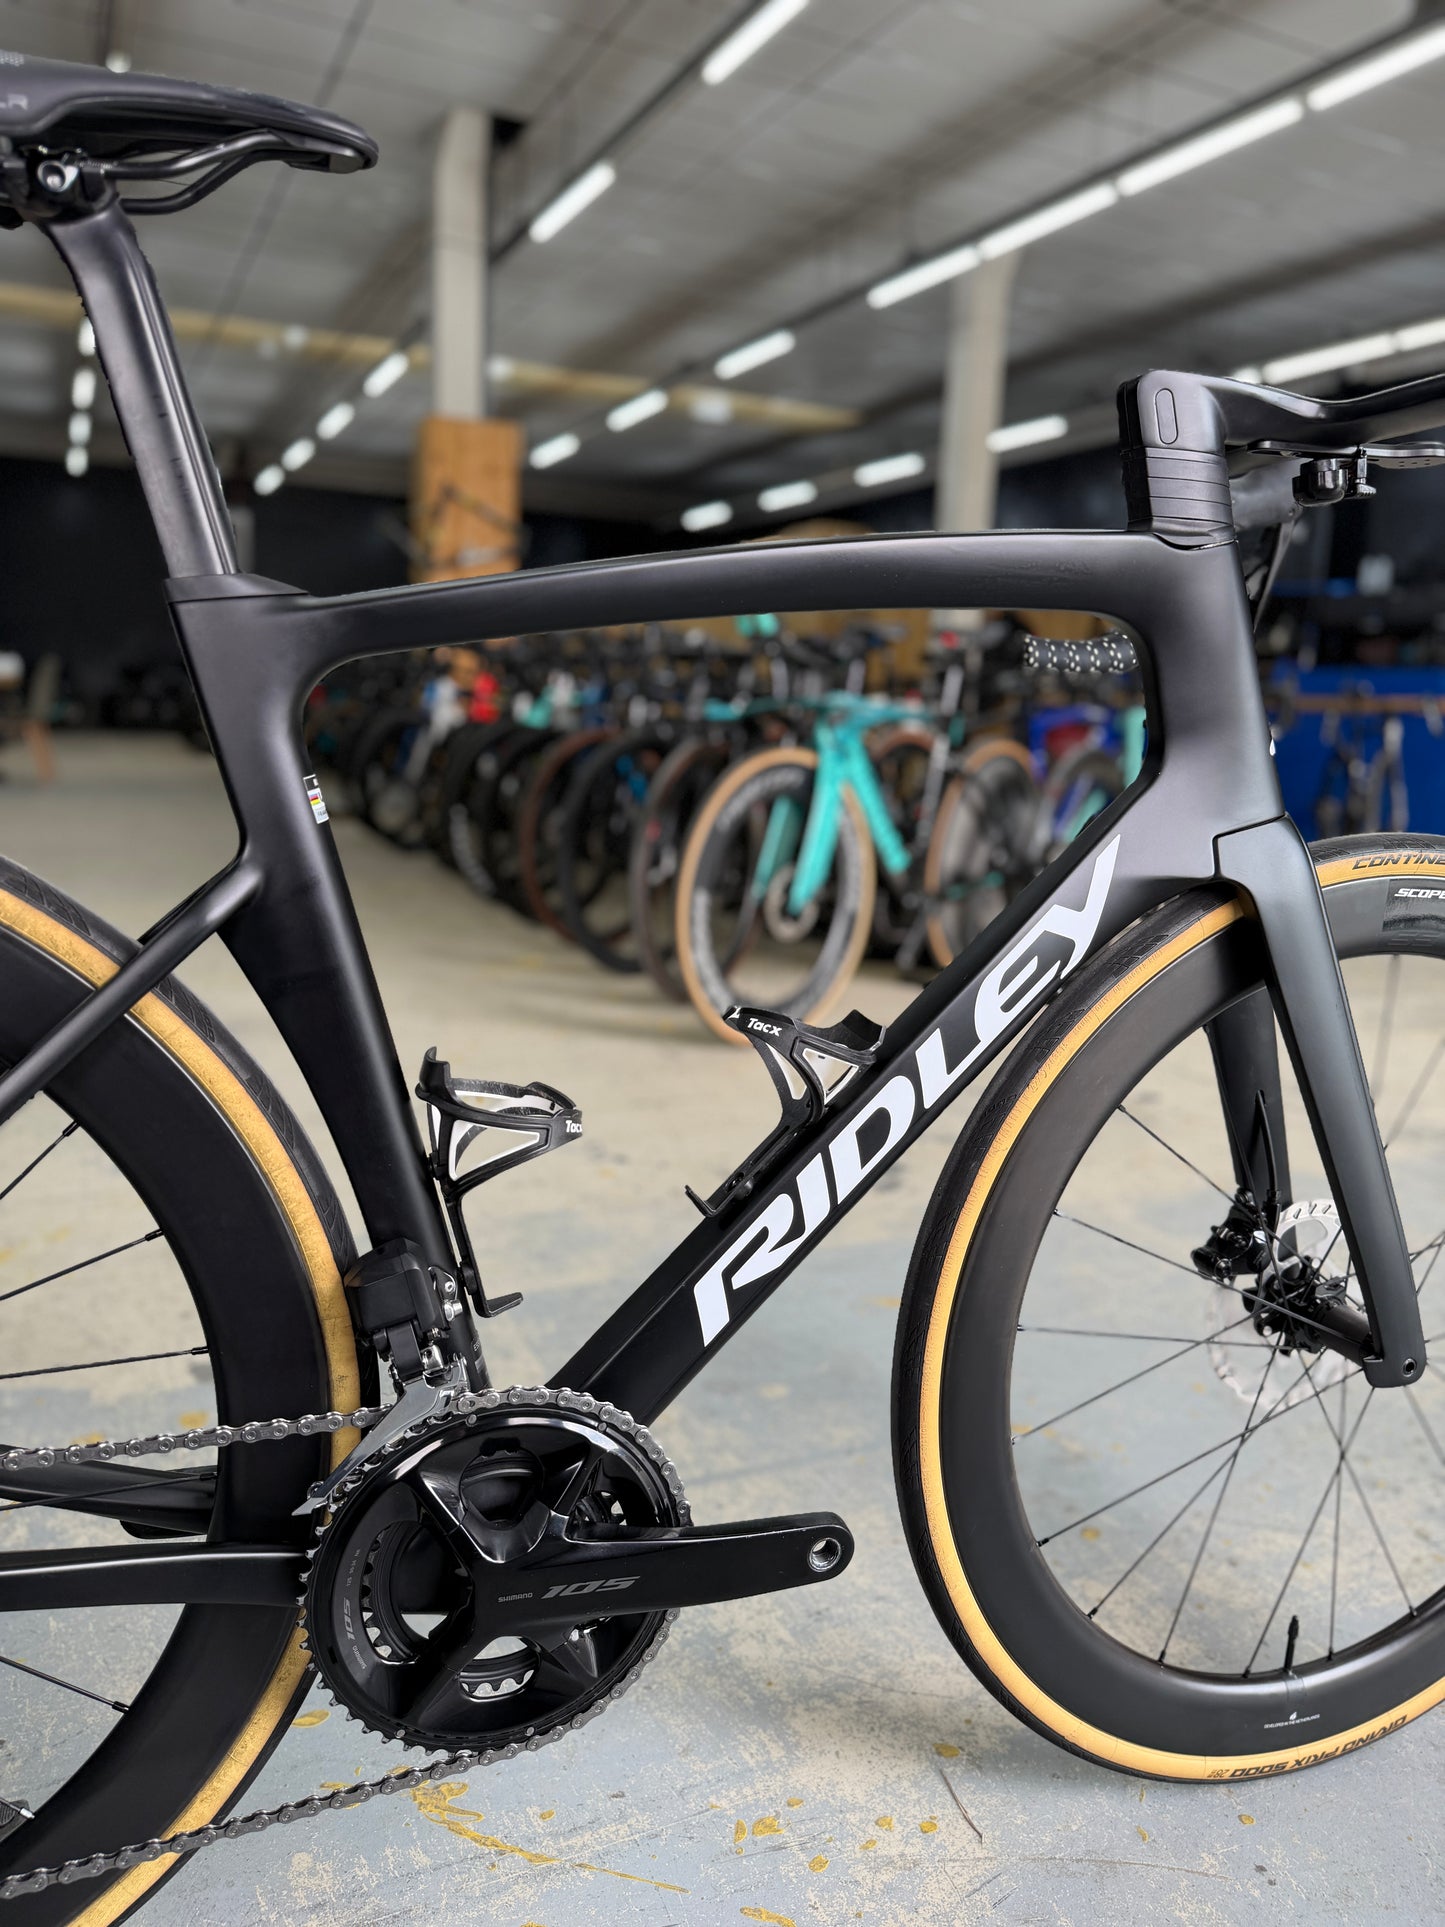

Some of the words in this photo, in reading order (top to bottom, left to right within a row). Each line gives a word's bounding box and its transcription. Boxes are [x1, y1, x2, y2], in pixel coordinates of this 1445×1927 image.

[747, 1017, 783, 1037] Tacx
[694, 834, 1120, 1348] RIDLEY
[565, 1119, 583, 1133] Tac
[498, 1592, 534, 1603] SHIMANO
[541, 1576, 641, 1600] 105
[1342, 1715, 1408, 1751] GRAND
[1293, 1746, 1340, 1768] PRIX
[1228, 1761, 1290, 1778] 5000
